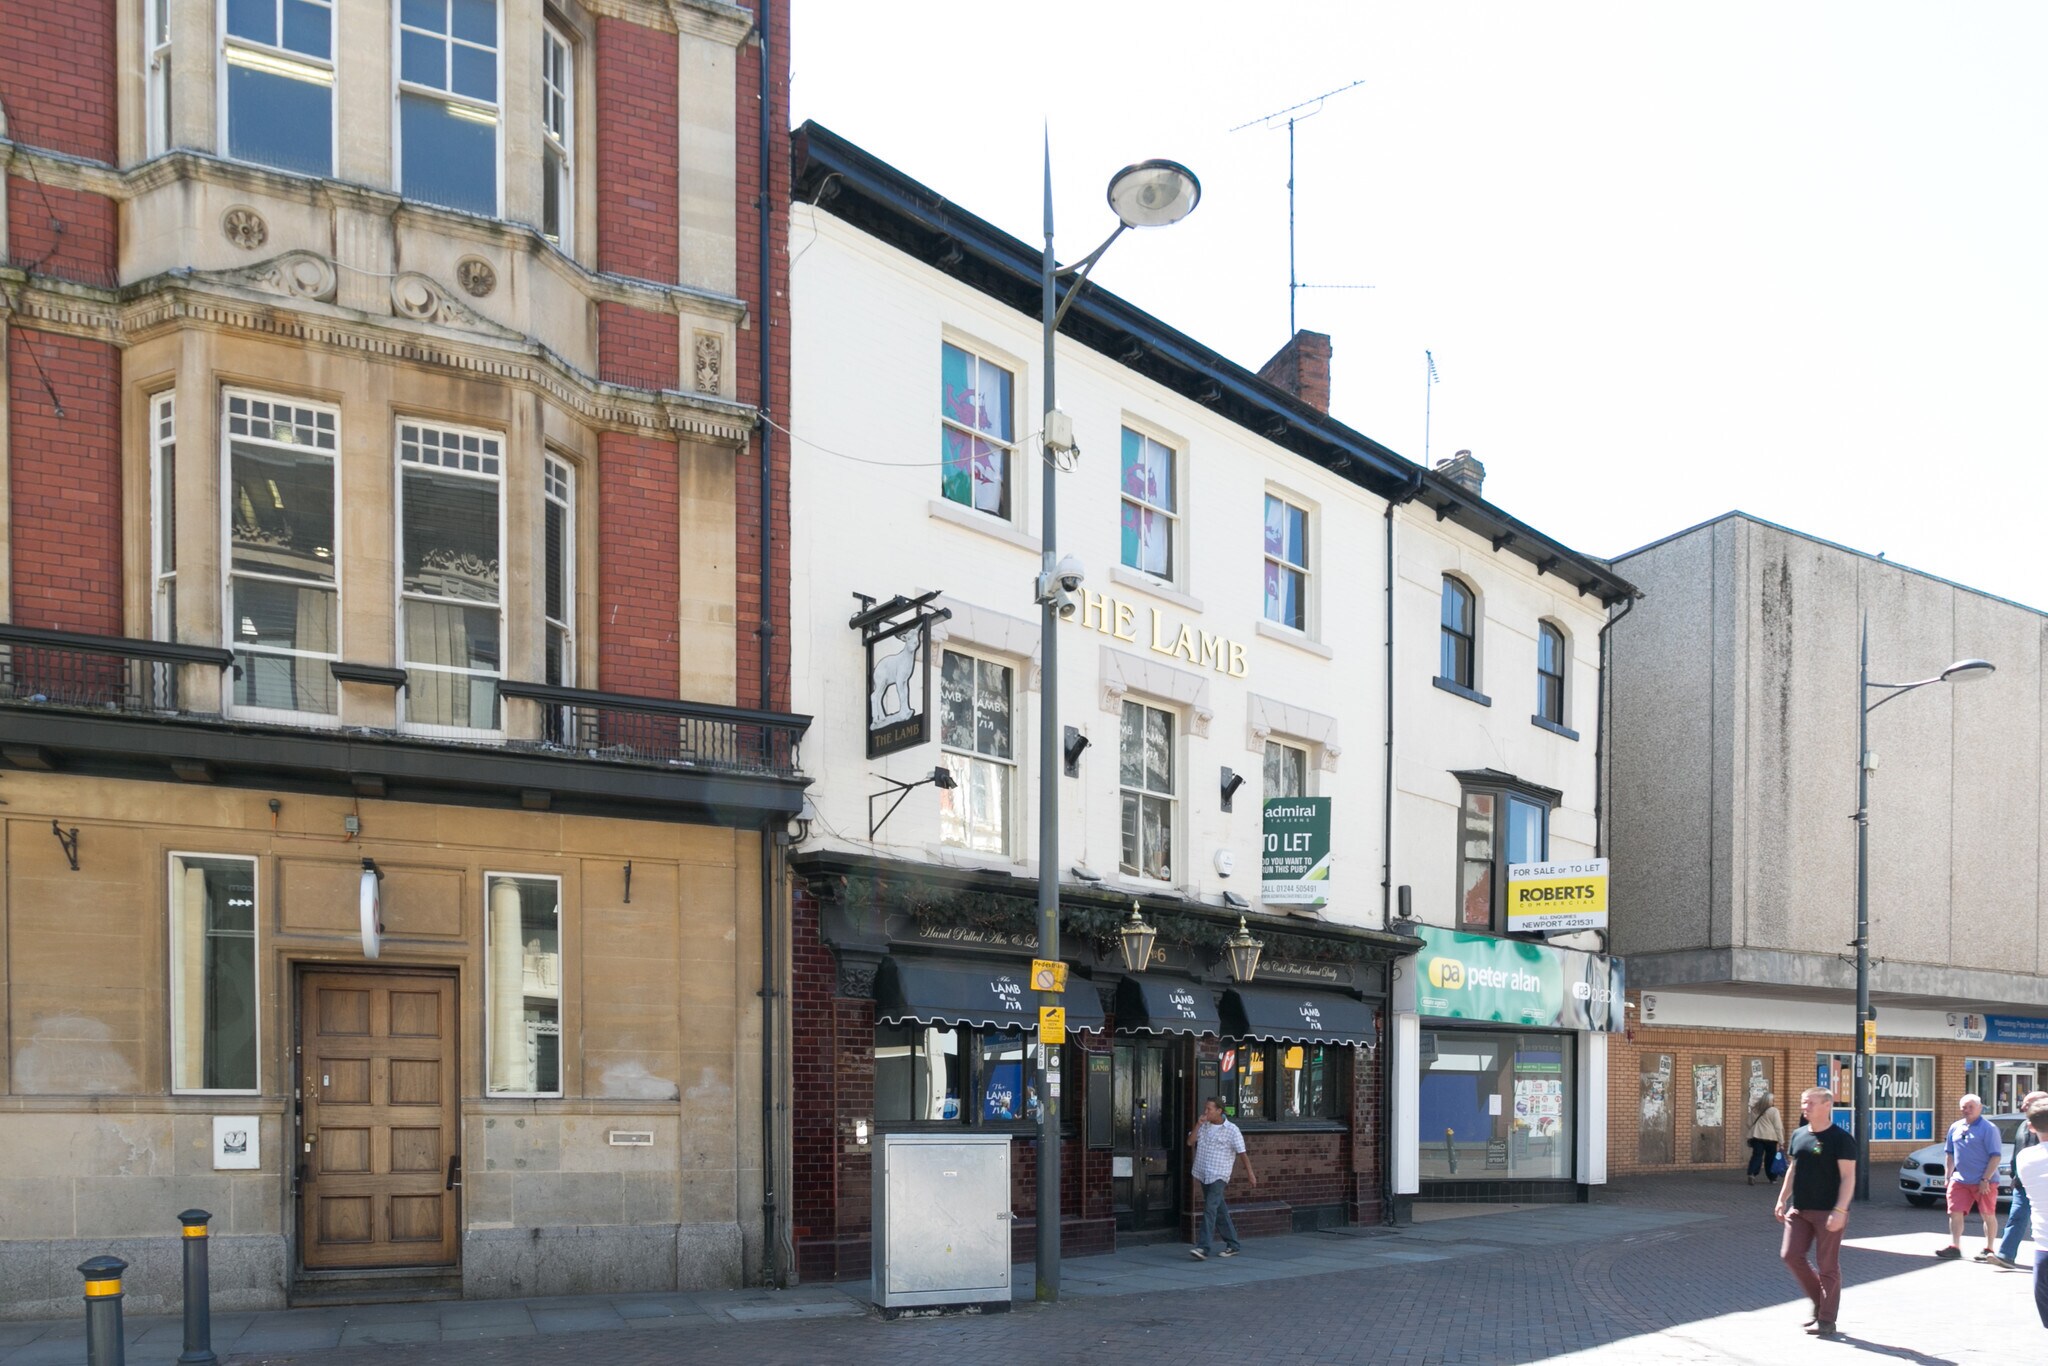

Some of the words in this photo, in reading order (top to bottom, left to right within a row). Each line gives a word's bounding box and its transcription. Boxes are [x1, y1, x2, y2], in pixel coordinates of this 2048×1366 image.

[1150, 607, 1249, 679] LAMB
[941, 691, 962, 703] AMB
[875, 733, 892, 748] THE
[894, 723, 920, 742] LAMB
[1265, 805, 1316, 818] admiral
[1284, 833, 1312, 852] LET
[1271, 857, 1284, 866] YOU
[1285, 857, 1303, 866] WANT
[1304, 857, 1313, 866] TO
[1275, 866, 1289, 874] THIS
[1290, 865, 1307, 874] PUB?
[1513, 868, 1531, 877] FOR
[1534, 867, 1555, 875] SALE
[1570, 865, 1582, 873] TO
[1585, 864, 1600, 872] LET
[1276, 884, 1294, 893] 01244
[1296, 884, 1317, 893] 505491
[1520, 885, 1595, 902] ROBERTS
[1520, 900, 1595, 908] COMMERCIAL
[1522, 920, 1563, 929] NEWPORT
[1565, 919, 1594, 927] 421531
[920, 926, 953, 939] Hand
[952, 926, 985, 942] Pulled
[985, 930, 1008, 945] Ales
[1010, 934, 1023, 946] &
[1024, 933, 1039, 949] La
[1272, 962, 1287, 973] Cold
[1321, 966, 1338, 981] Daily
[1441, 963, 1460, 988] pa
[1467, 966, 1508, 991] peter
[1510, 967, 1541, 993] alan
[990, 982, 1021, 994] LAMB
[1579, 985, 1589, 999] pa
[1169, 994, 1195, 1005] LAMB
[1299, 1007, 1321, 1017] LAMB
[1956, 1030, 1964, 1038] St
[1091, 1064, 1110, 1072] LAMB
[1200, 1069, 1216, 1077] LAMB
[1879, 1074, 1919, 1098] Pauls
[986, 1090, 1012, 1100] LAMB
[1239, 1096, 1258, 1104] LAMB
